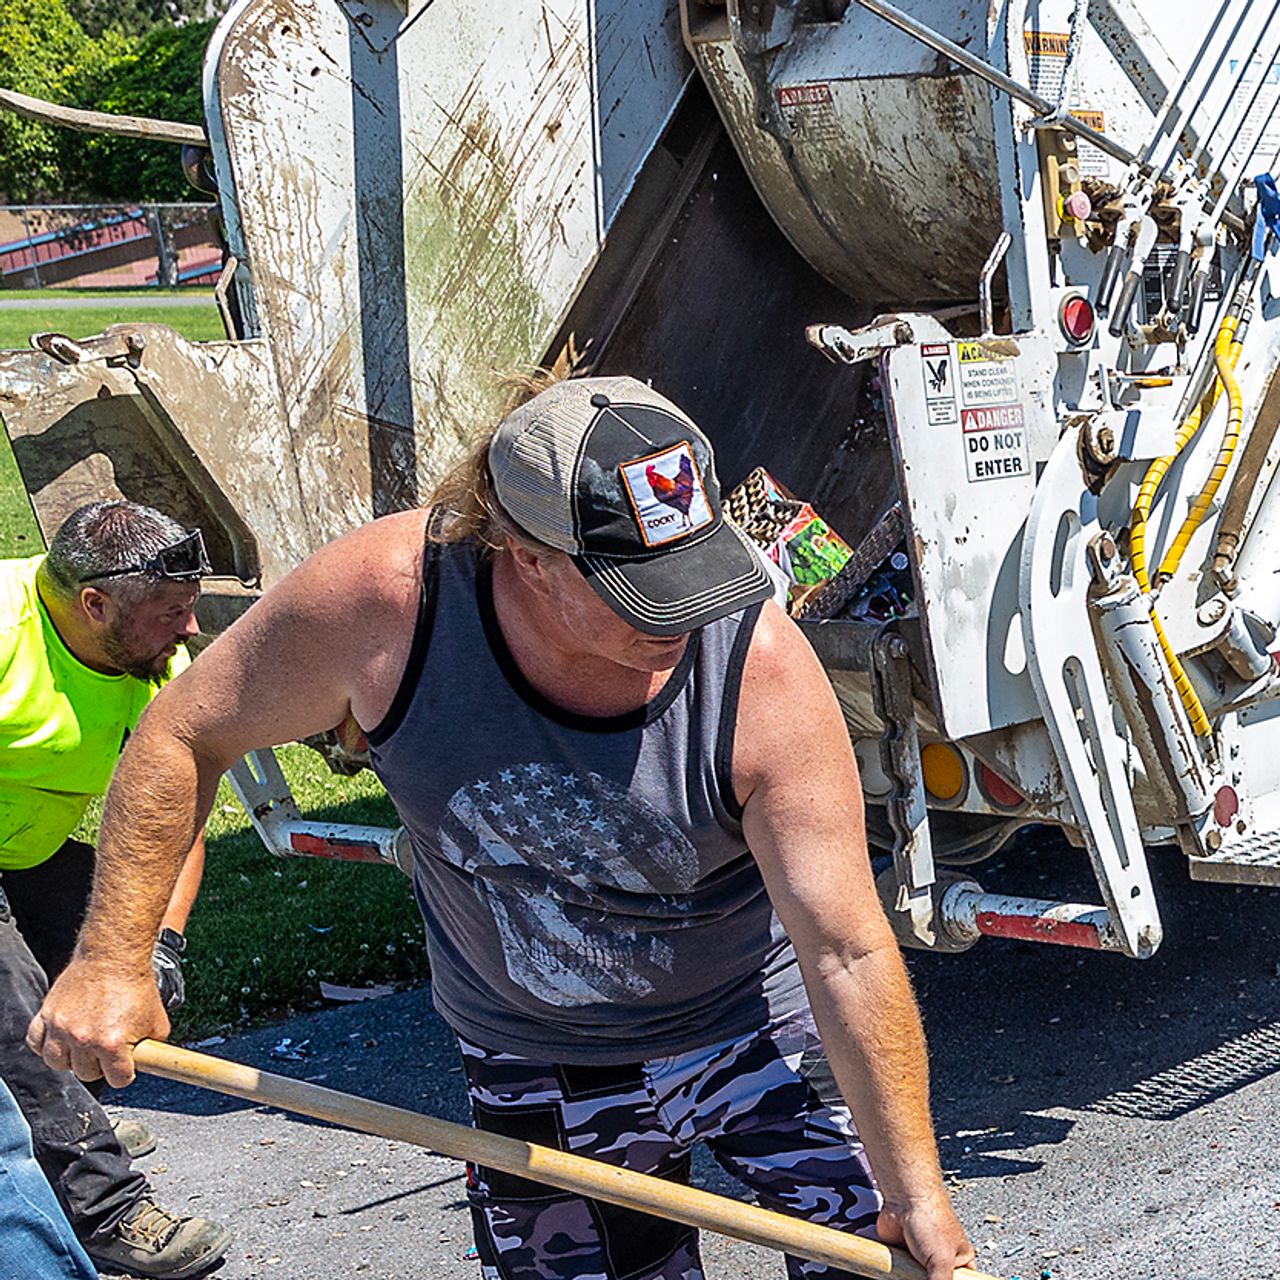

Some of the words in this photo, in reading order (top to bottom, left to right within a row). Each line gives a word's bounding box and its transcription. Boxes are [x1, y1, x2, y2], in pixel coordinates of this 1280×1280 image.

[1025, 36, 1068, 55] WARNIN
[968, 369, 987, 378] STAND
[988, 367, 1008, 376] CLEAR
[963, 380, 981, 388] WHEN
[974, 390, 992, 398] BEING
[977, 408, 1023, 429] DANGER
[968, 436, 989, 453] DO
[994, 433, 1022, 451] NOT
[975, 457, 1022, 477] ENTER
